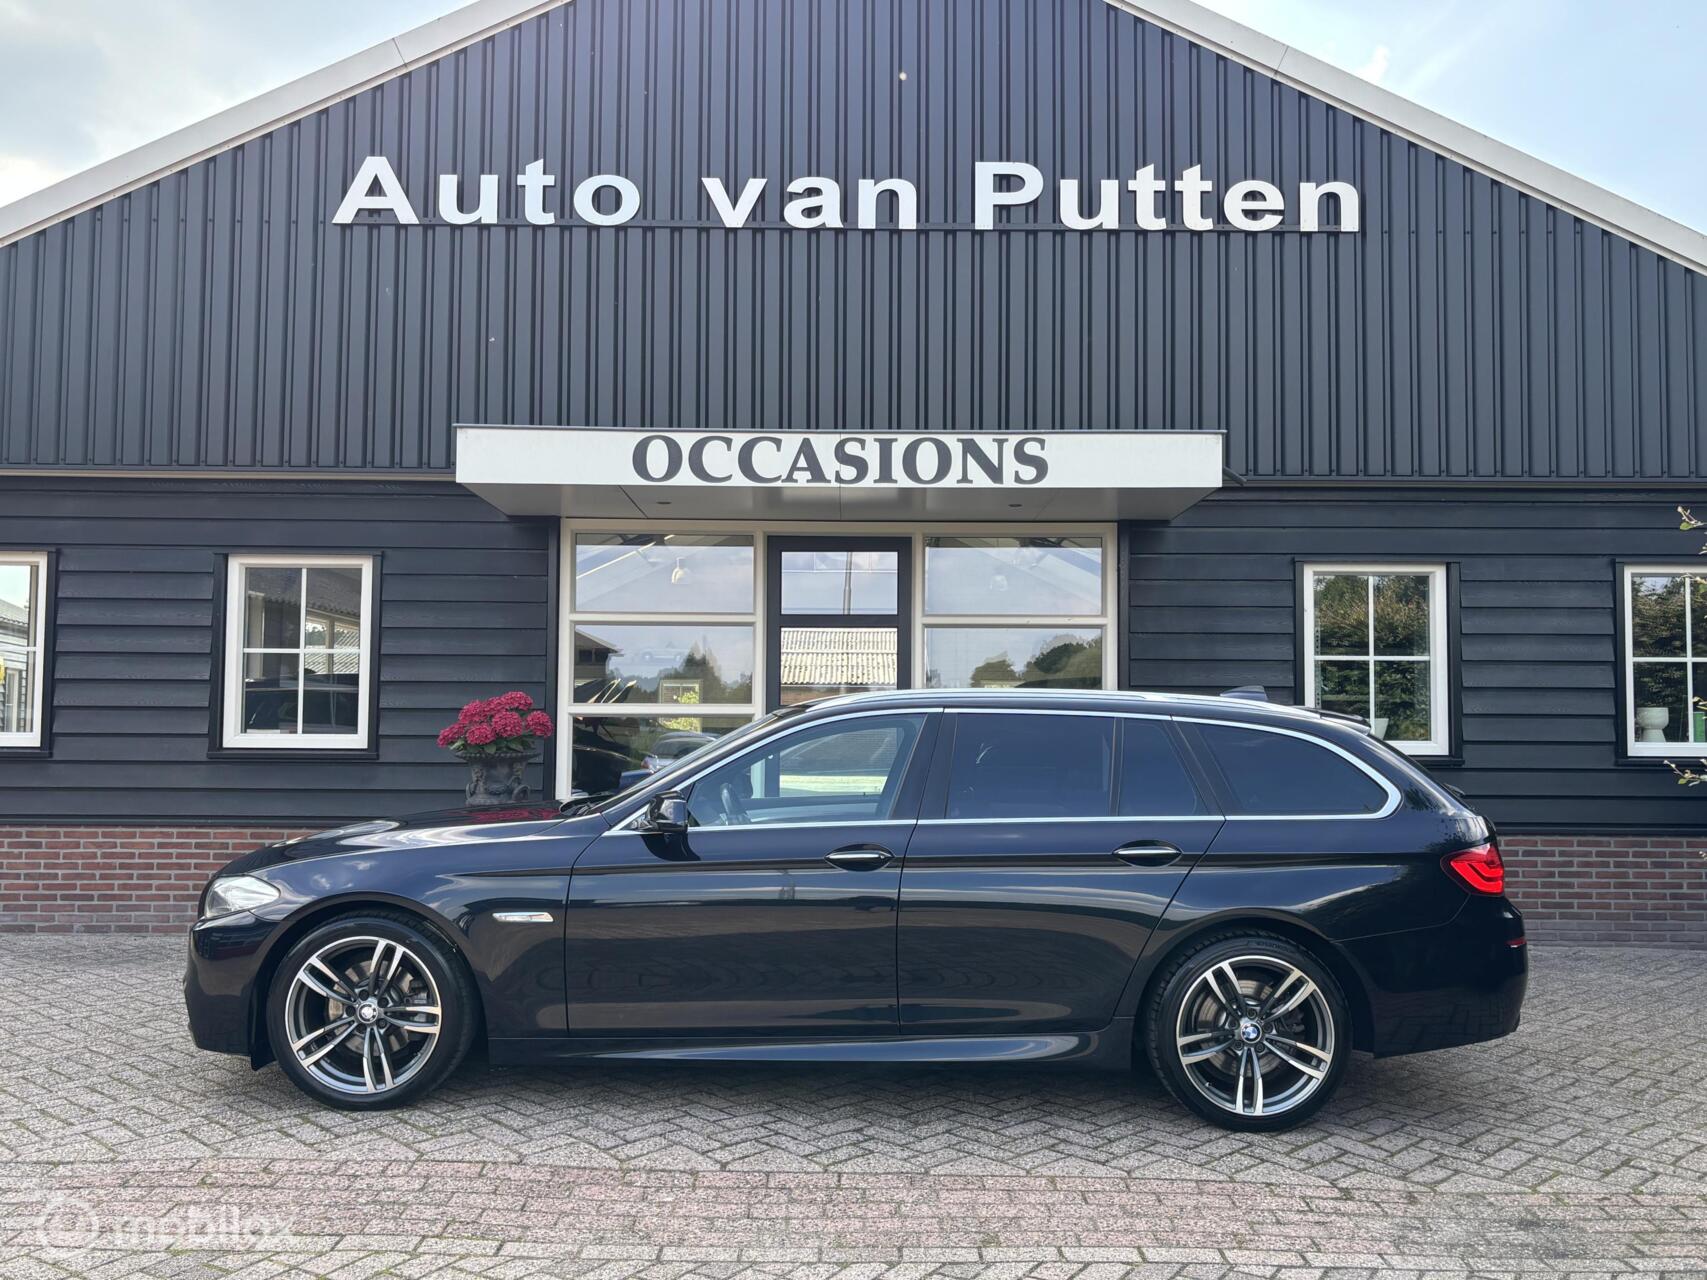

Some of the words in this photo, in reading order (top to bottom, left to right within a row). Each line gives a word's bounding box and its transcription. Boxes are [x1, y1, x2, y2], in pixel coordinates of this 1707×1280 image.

[332, 156, 640, 227] Auto
[702, 177, 917, 230] van
[974, 161, 1362, 234] Putten
[632, 433, 1049, 486] OCCASIONS
